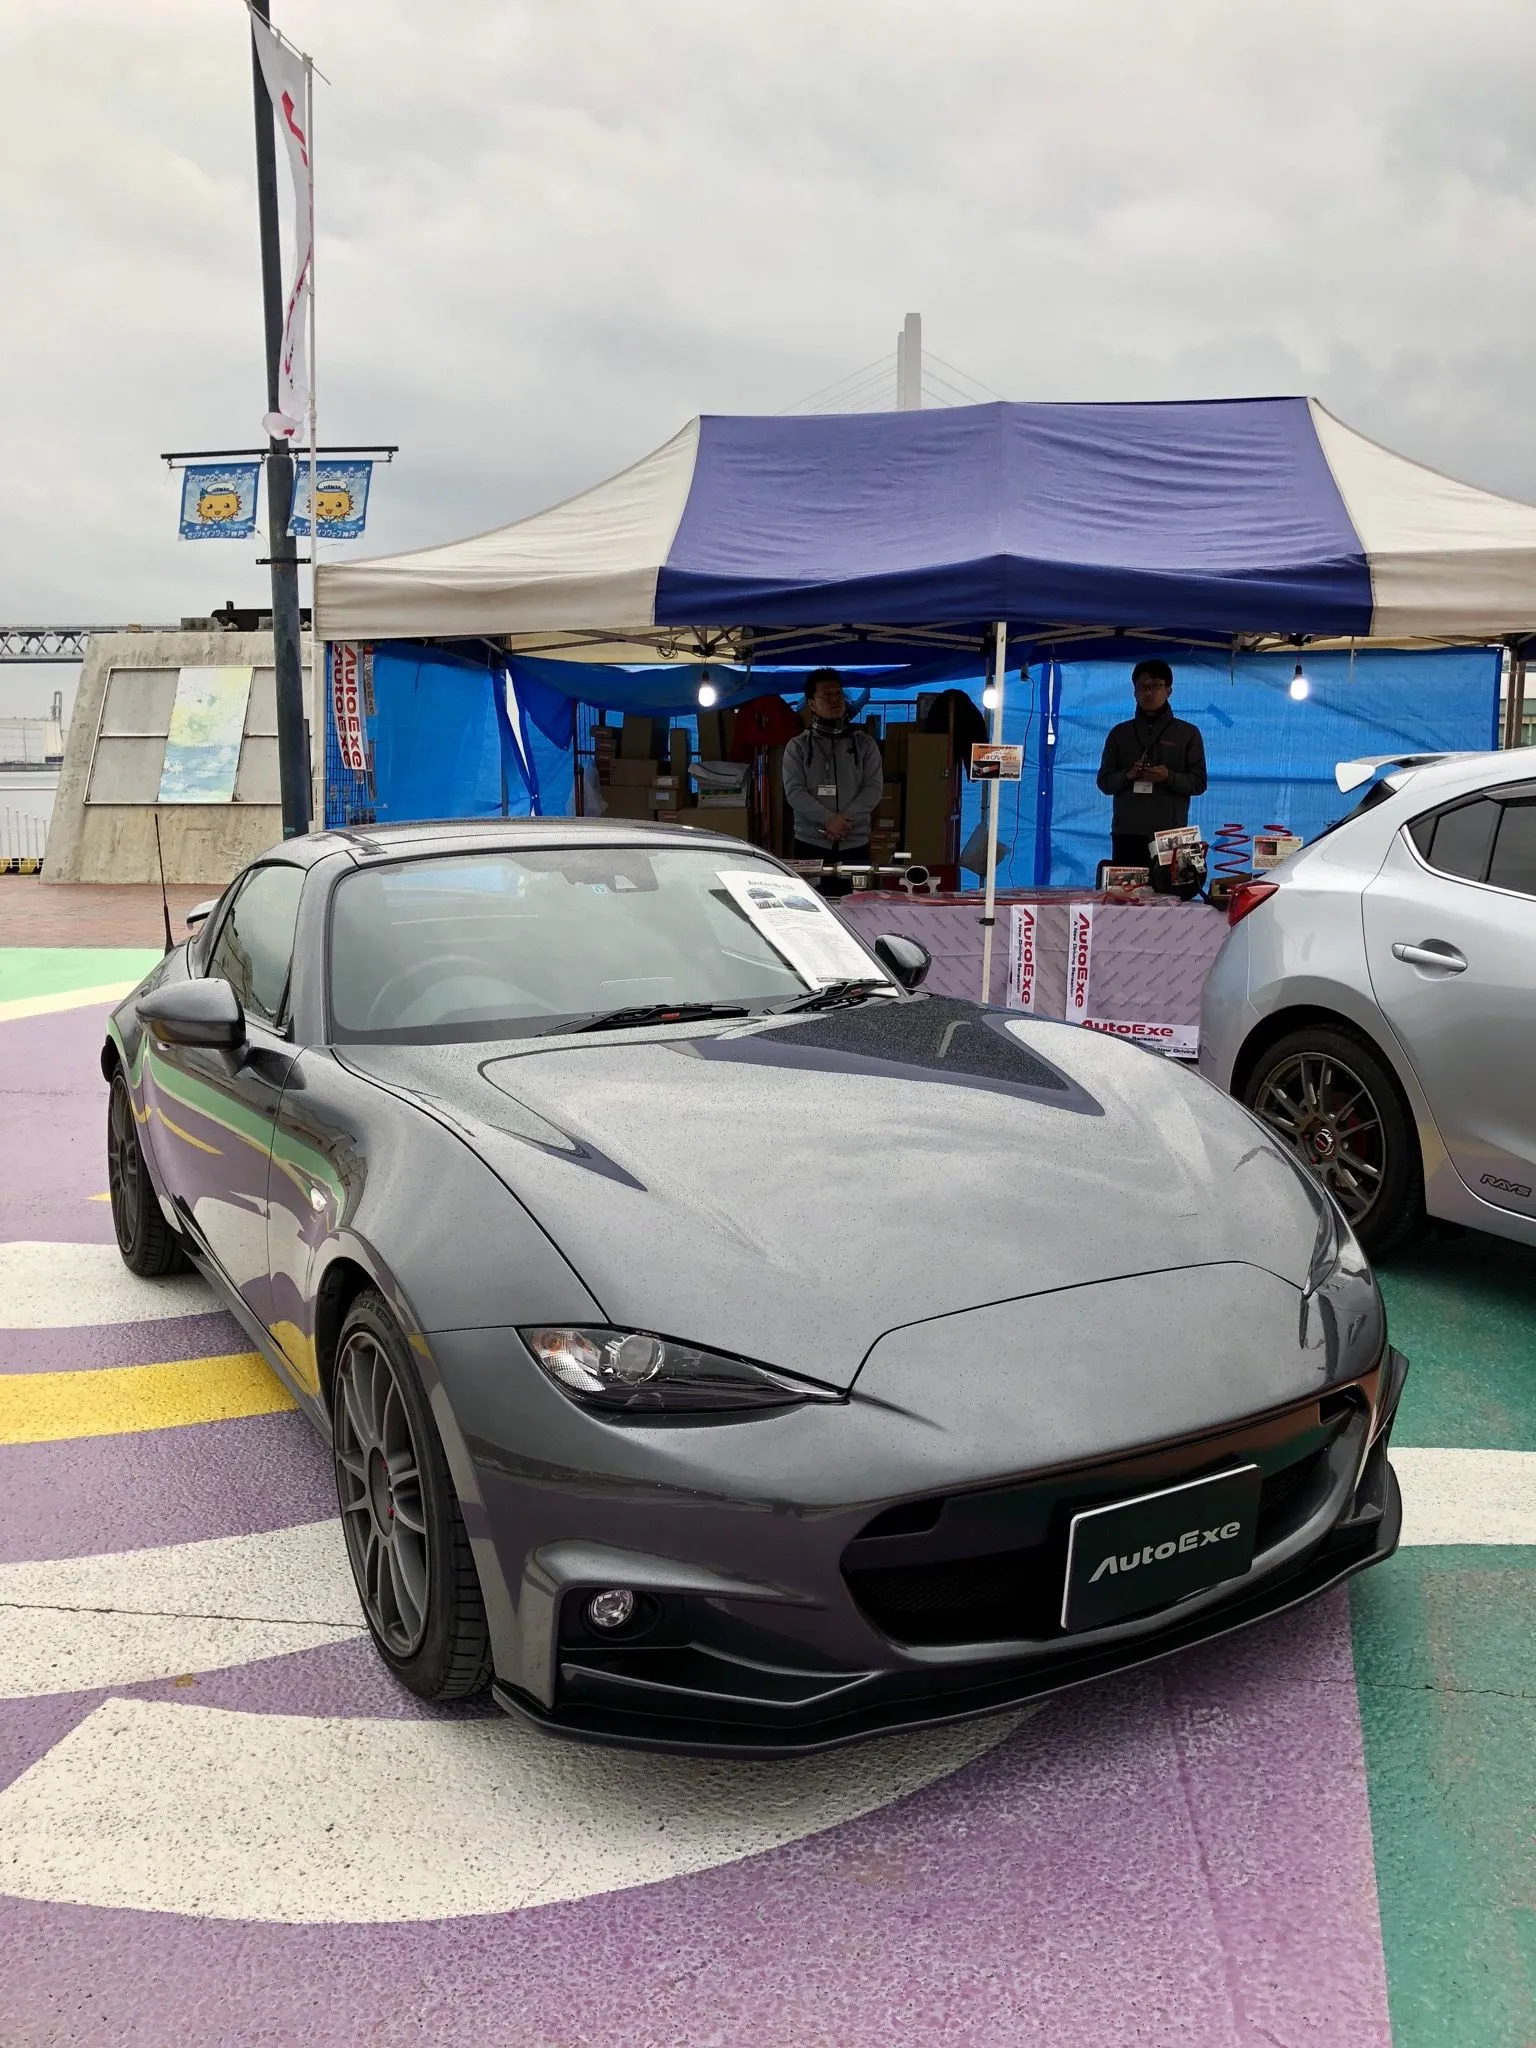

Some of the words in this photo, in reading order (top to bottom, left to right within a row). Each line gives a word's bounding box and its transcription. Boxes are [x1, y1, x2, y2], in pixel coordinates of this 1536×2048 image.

[344, 643, 363, 769] AutoExe
[1022, 908, 1035, 1005] AutoExe
[1075, 912, 1090, 1008] AutoExe
[1480, 1173, 1532, 1198] RAYS
[1088, 1520, 1241, 1584] AutoExe
